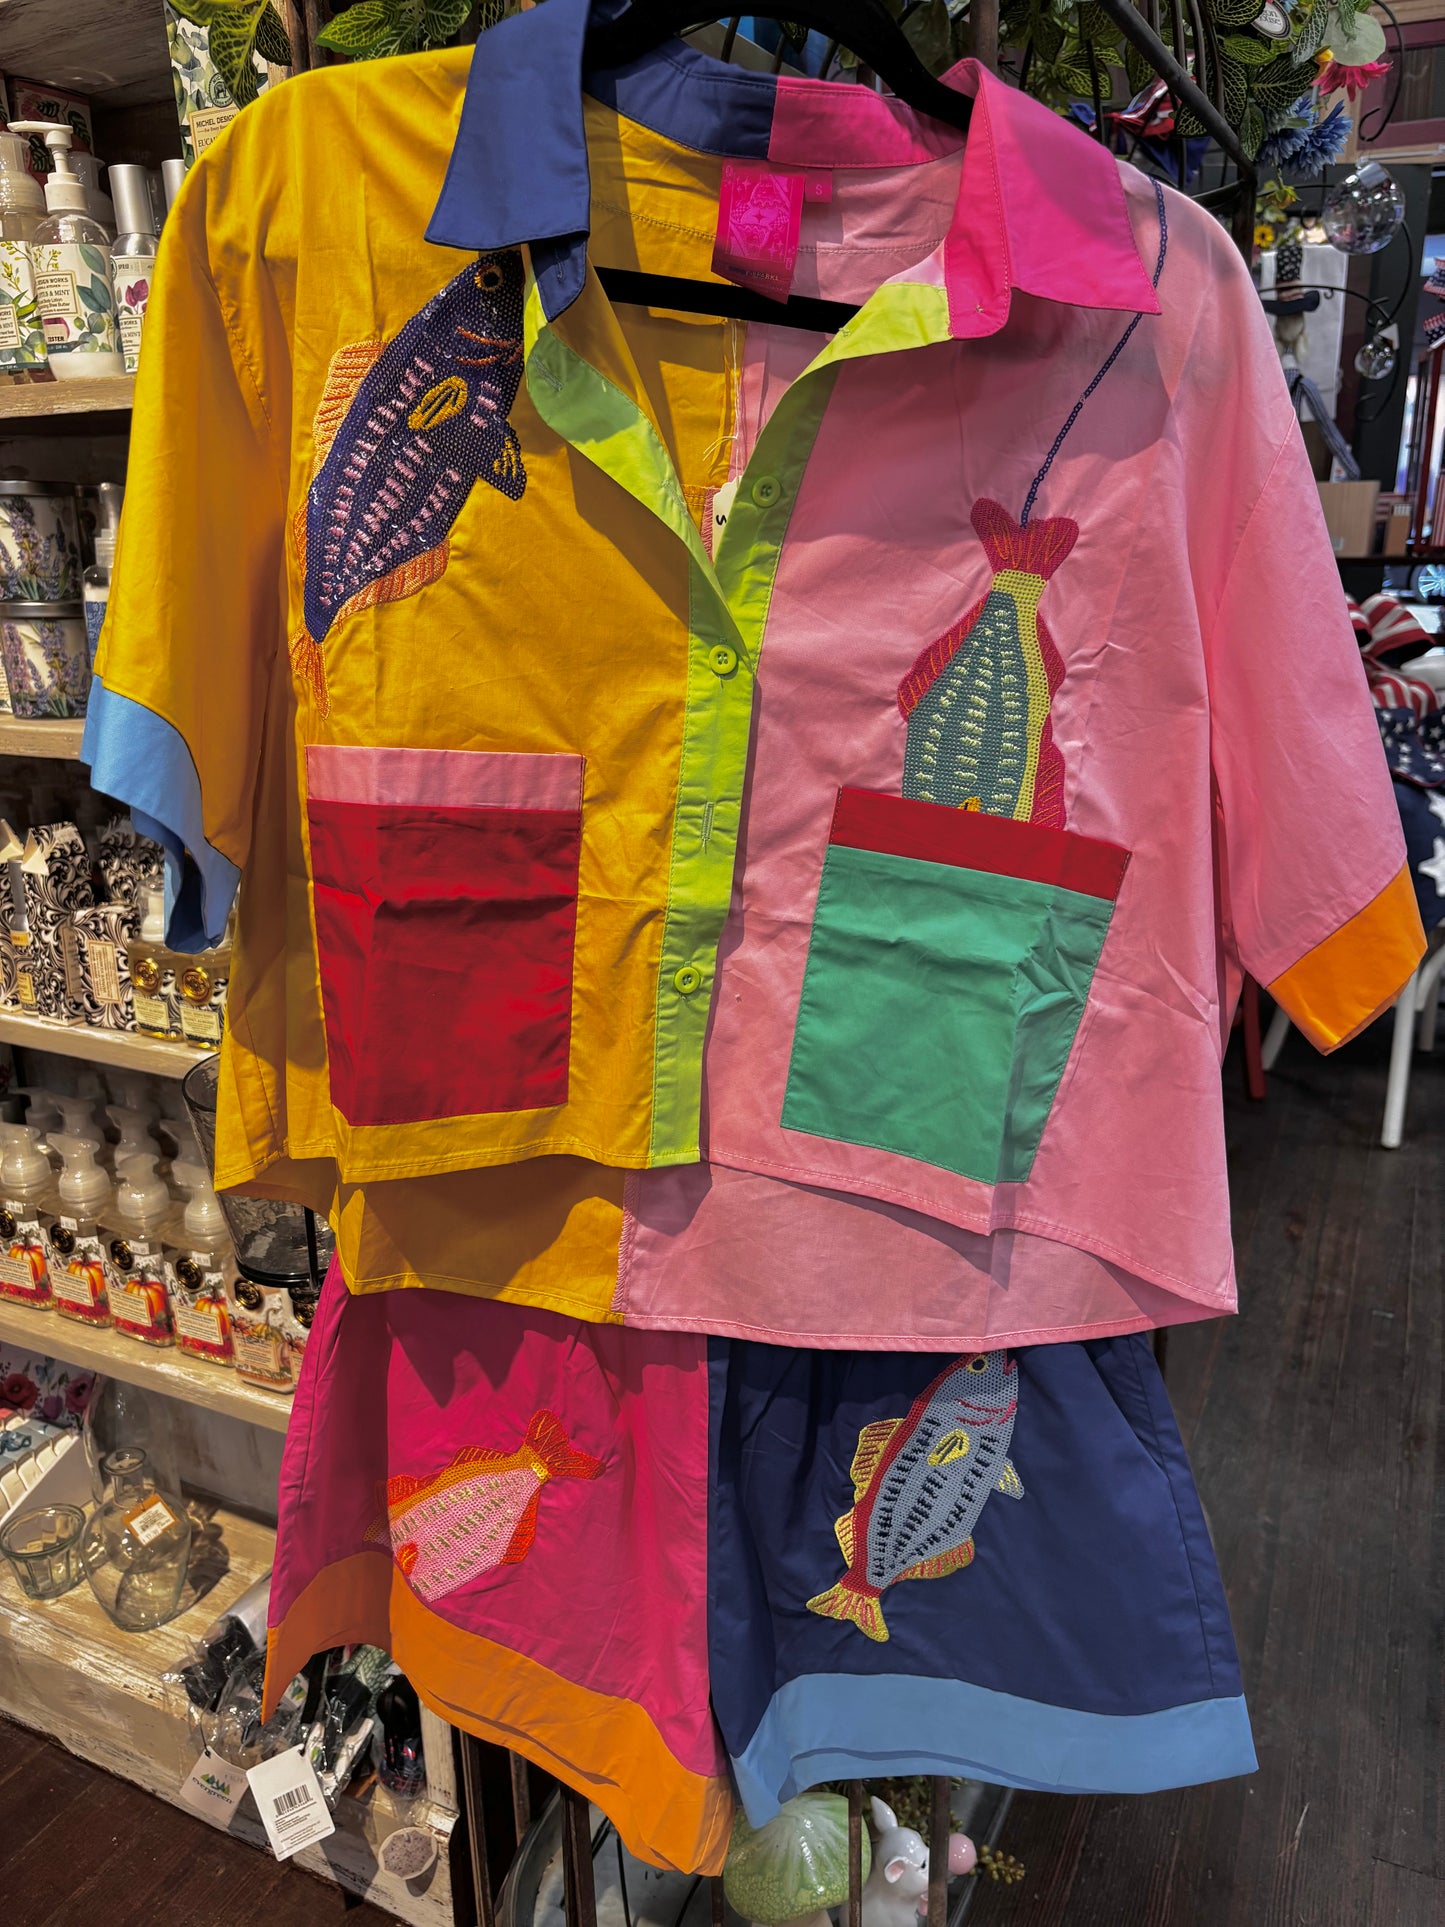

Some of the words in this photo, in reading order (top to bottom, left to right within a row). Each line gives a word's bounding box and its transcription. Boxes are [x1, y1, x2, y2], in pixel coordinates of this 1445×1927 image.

[196, 118, 215, 128] MICHEL
[815, 184, 823, 196] S
[54, 289, 70, 297] MINT
[192, 1776, 233, 1804] evergreen
